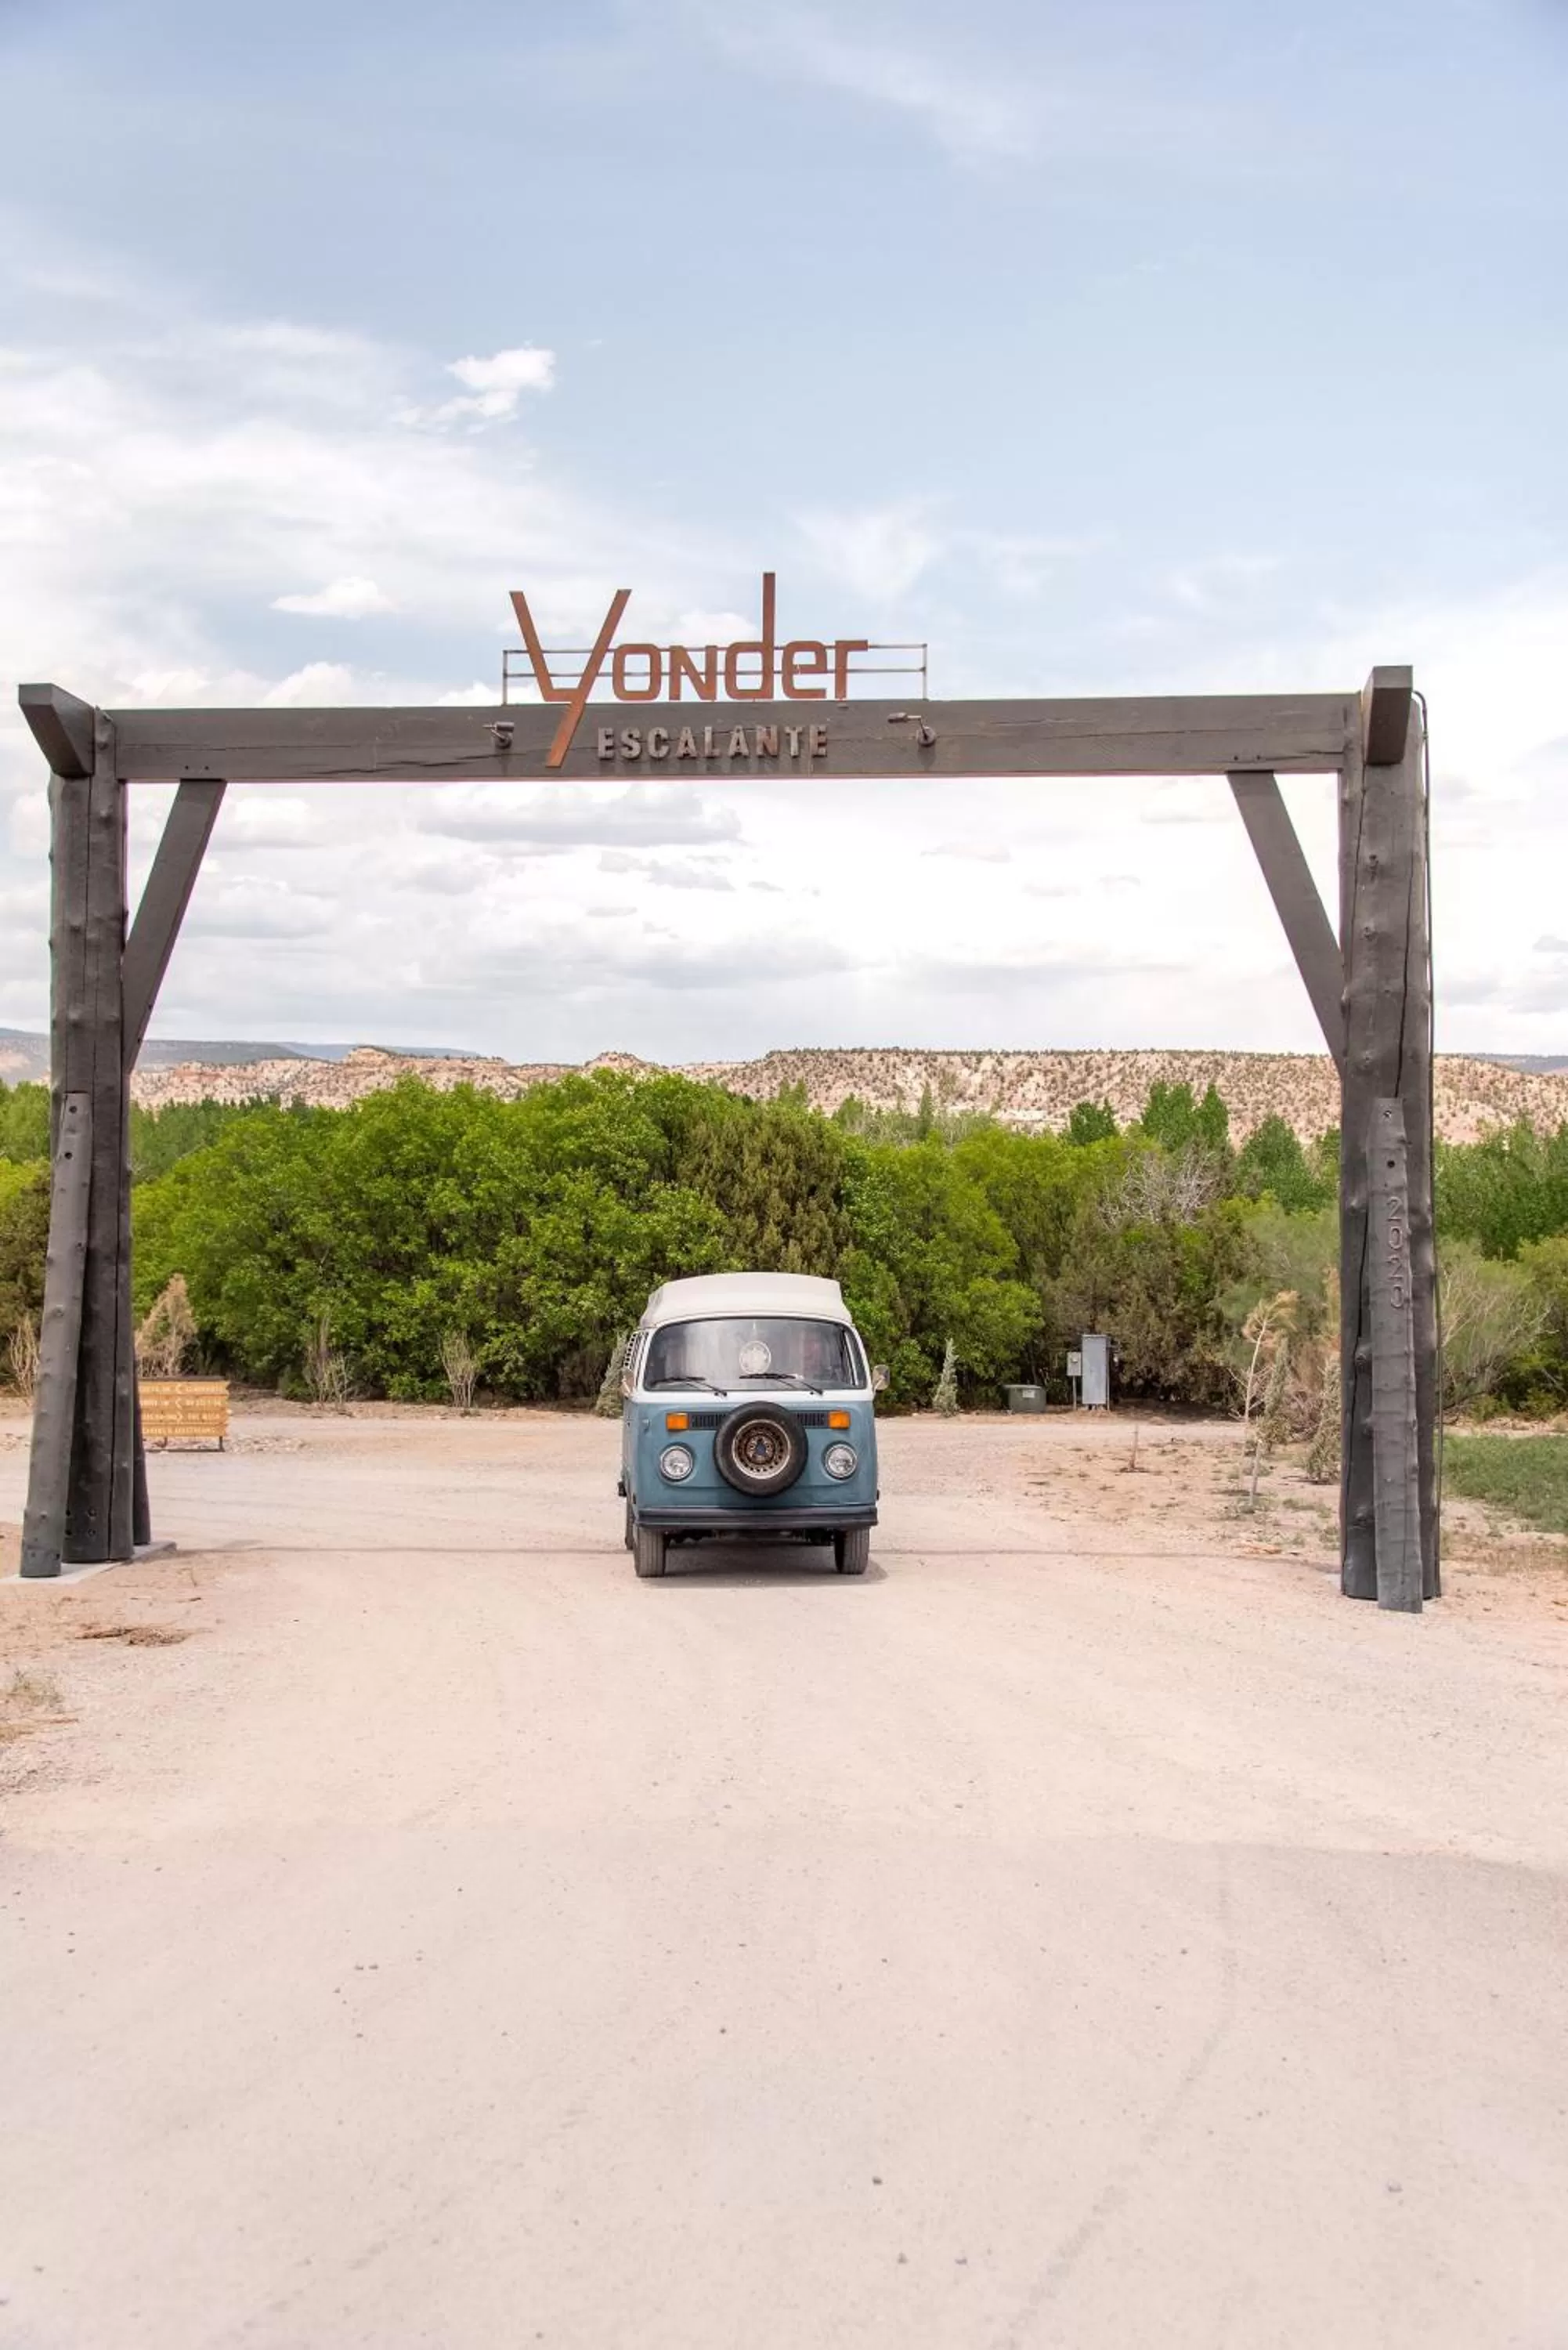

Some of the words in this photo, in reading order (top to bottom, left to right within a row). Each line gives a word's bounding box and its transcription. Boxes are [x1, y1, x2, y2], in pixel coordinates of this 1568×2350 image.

[509, 571, 869, 768] Yonder
[598, 725, 829, 759] ESCALANTE
[1386, 1196, 1404, 1309] 2020
